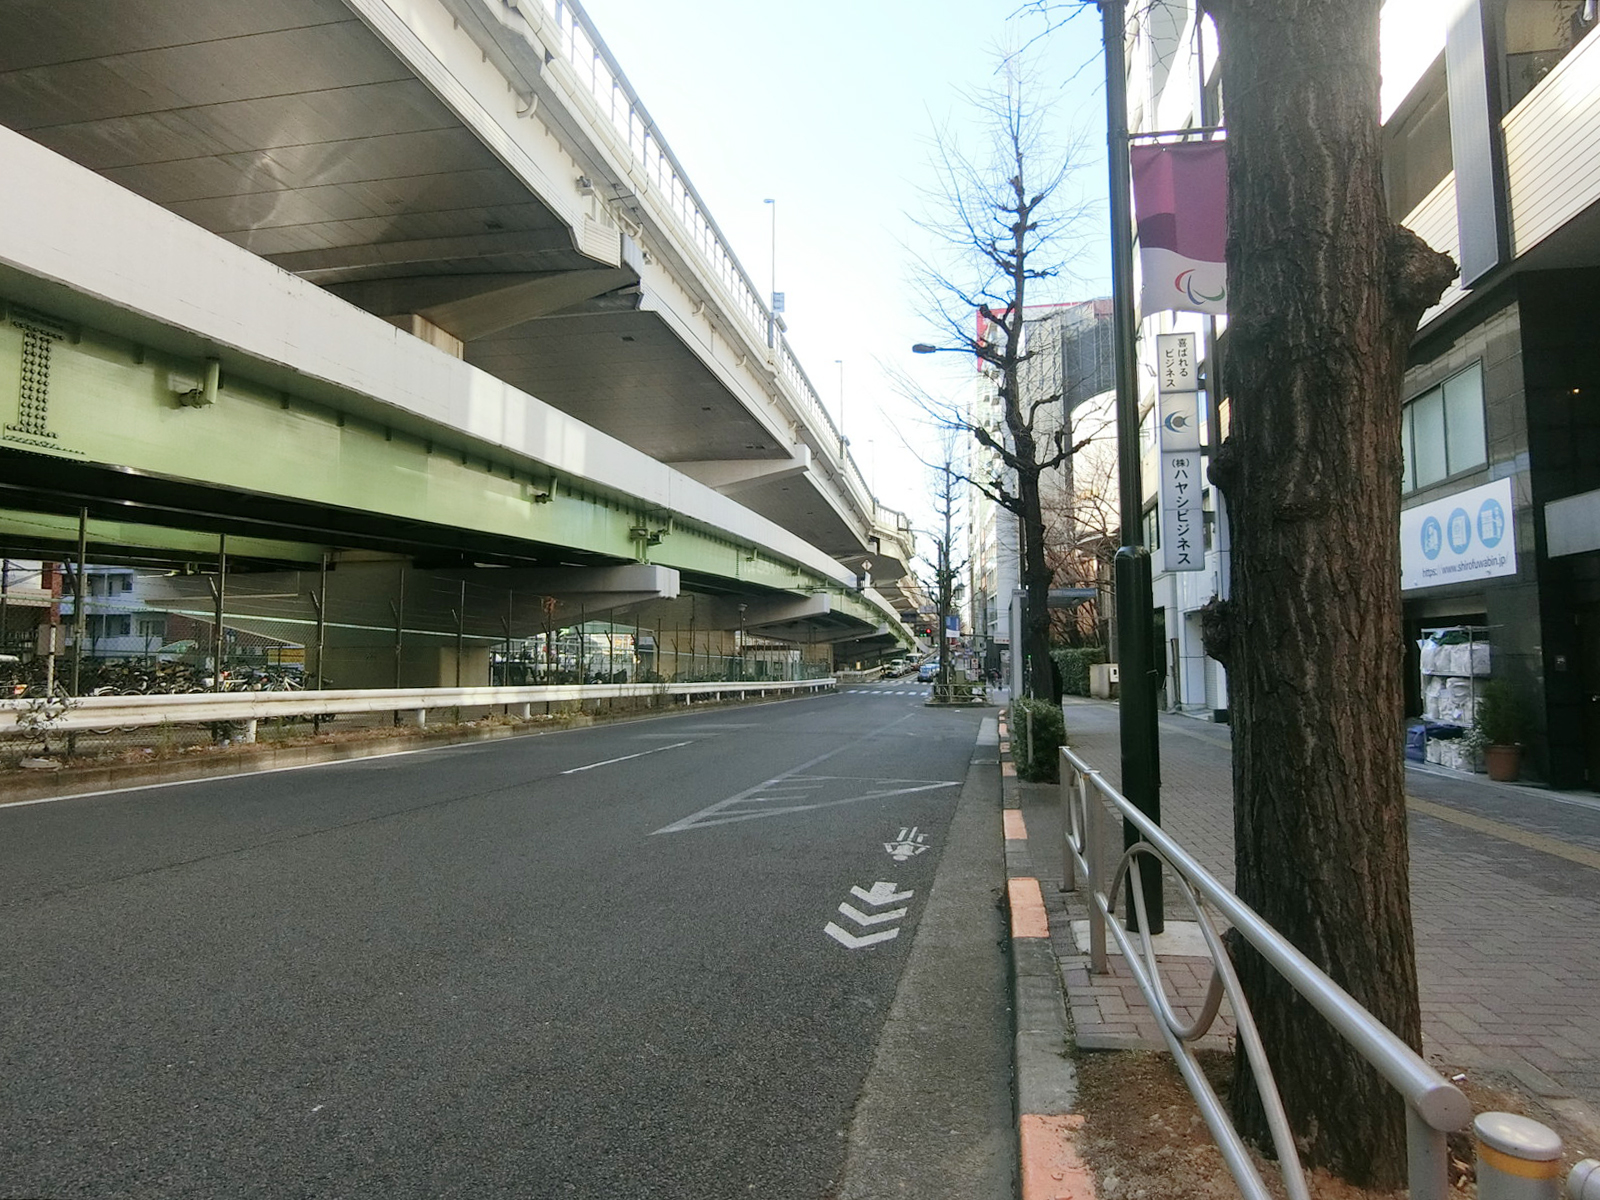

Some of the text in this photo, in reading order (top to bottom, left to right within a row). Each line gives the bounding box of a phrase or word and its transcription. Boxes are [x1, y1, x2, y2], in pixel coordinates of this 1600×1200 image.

[1165, 348, 1176, 388] ビジネス
[1177, 338, 1188, 377] 喜ばれる
